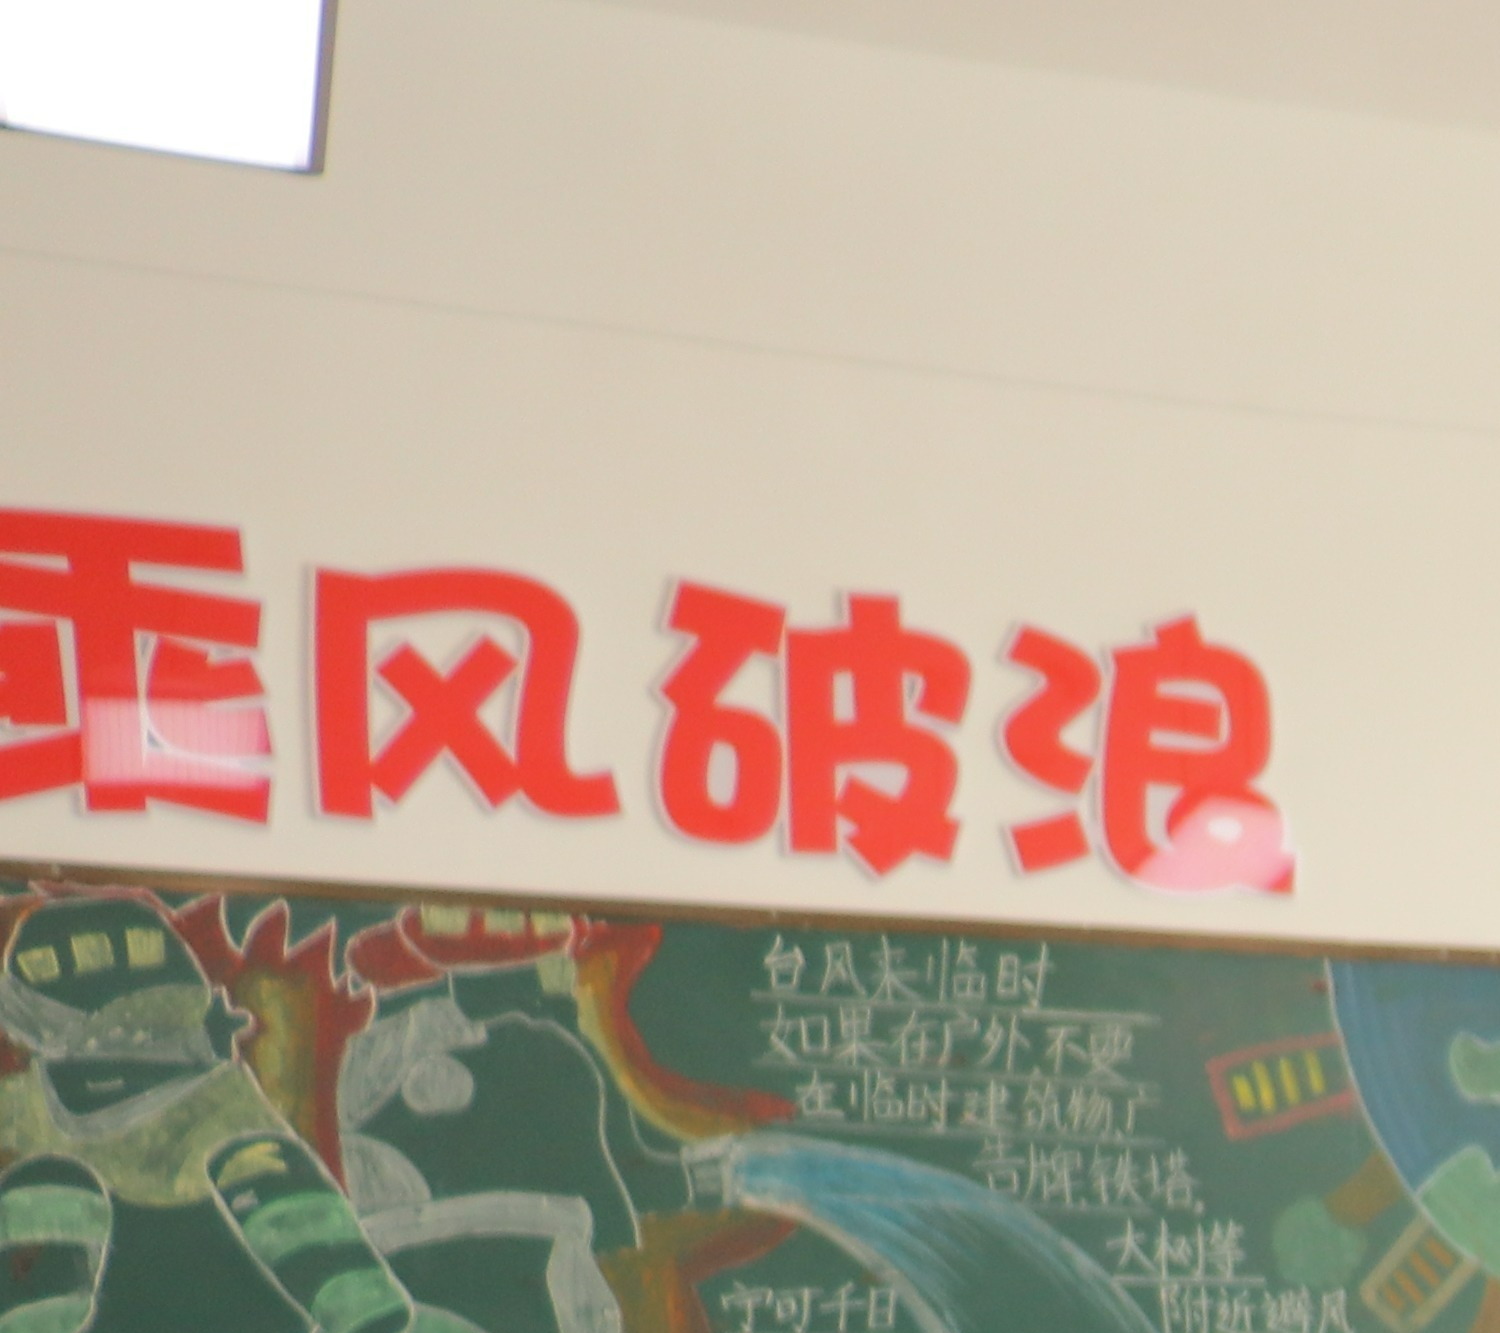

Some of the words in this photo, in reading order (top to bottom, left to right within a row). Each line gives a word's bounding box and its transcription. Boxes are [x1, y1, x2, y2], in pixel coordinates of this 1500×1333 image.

[0, 507, 1297, 895] 乘风破浪
[763, 934, 1056, 1010] 台风来临时
[757, 1004, 1136, 1090] 如果在户外不要
